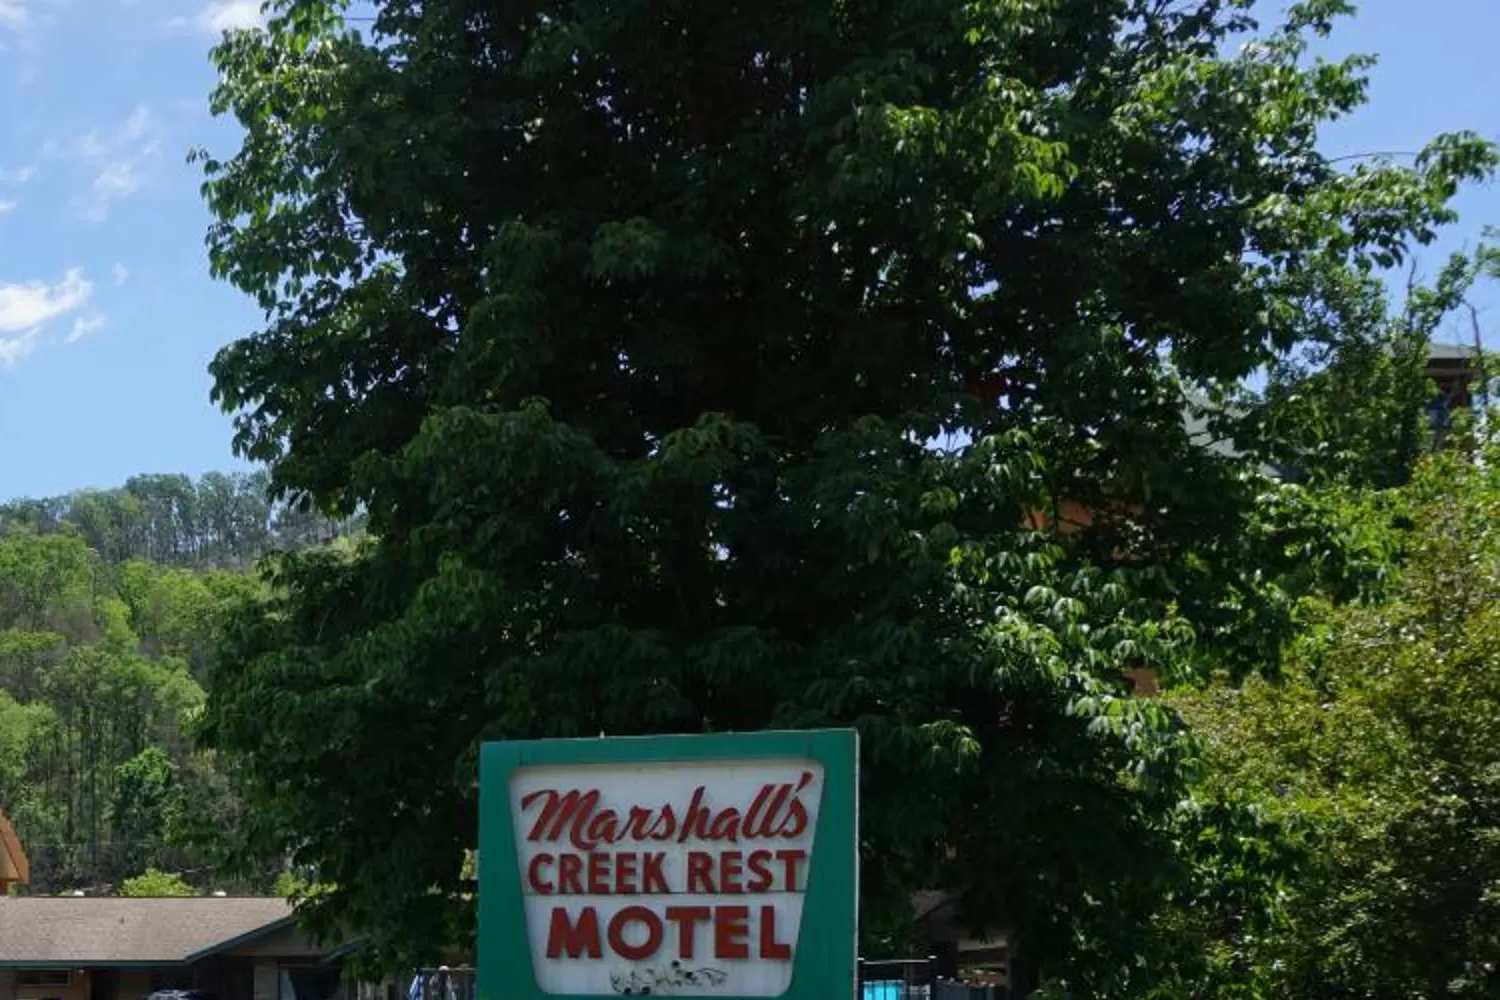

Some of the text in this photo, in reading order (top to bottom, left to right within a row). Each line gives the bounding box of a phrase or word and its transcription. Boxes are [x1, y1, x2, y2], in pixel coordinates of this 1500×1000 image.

[528, 849, 806, 894] CREEK REST
[546, 905, 792, 961] MOTEL
